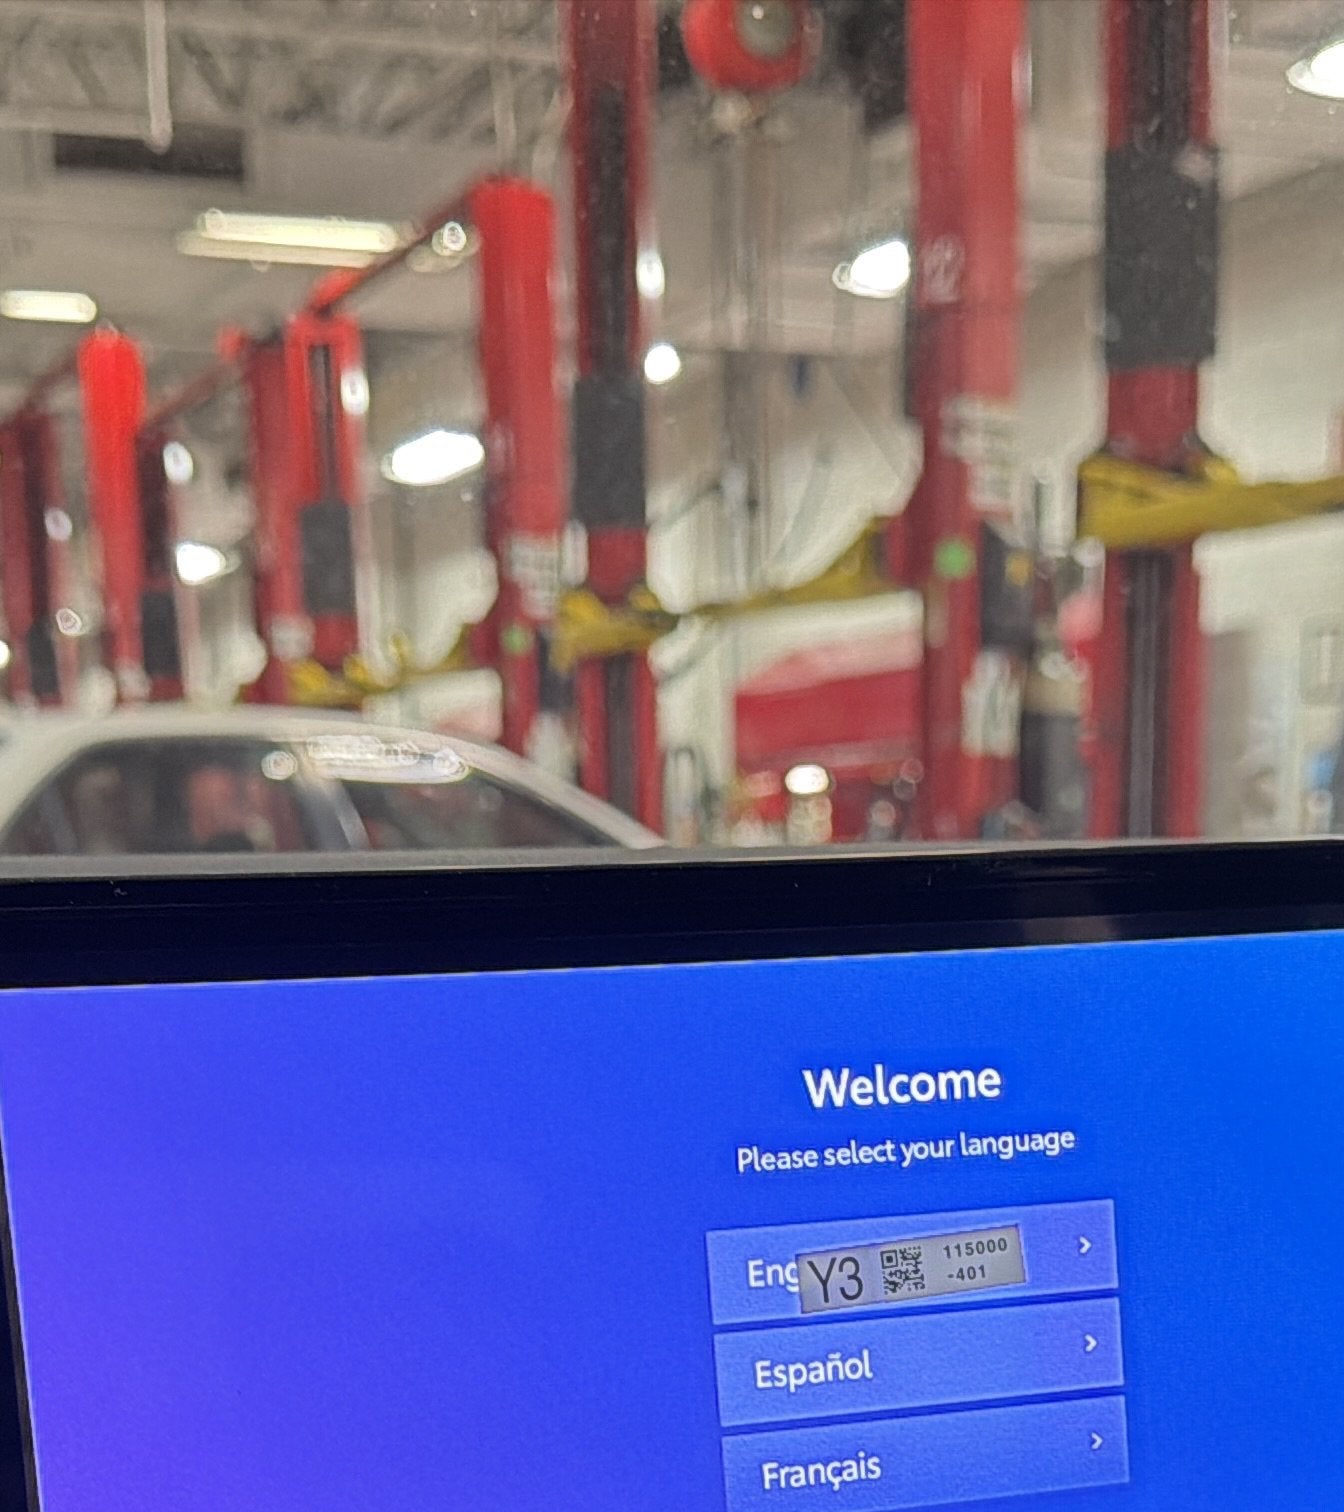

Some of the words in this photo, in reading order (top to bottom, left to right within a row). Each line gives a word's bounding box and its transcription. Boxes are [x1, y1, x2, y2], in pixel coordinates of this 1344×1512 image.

[802, 1064, 1002, 1108] Welcome
[737, 1143, 819, 1173] Please
[824, 1137, 896, 1167] select
[901, 1137, 954, 1168] your
[959, 1128, 1075, 1160] language
[942, 1237, 1008, 1259] 115000
[747, 1259, 799, 1293] Eng
[806, 1256, 863, 1304] Y3
[947, 1264, 987, 1282] -401
[755, 1349, 873, 1392] Español
[762, 1451, 882, 1490] Français
